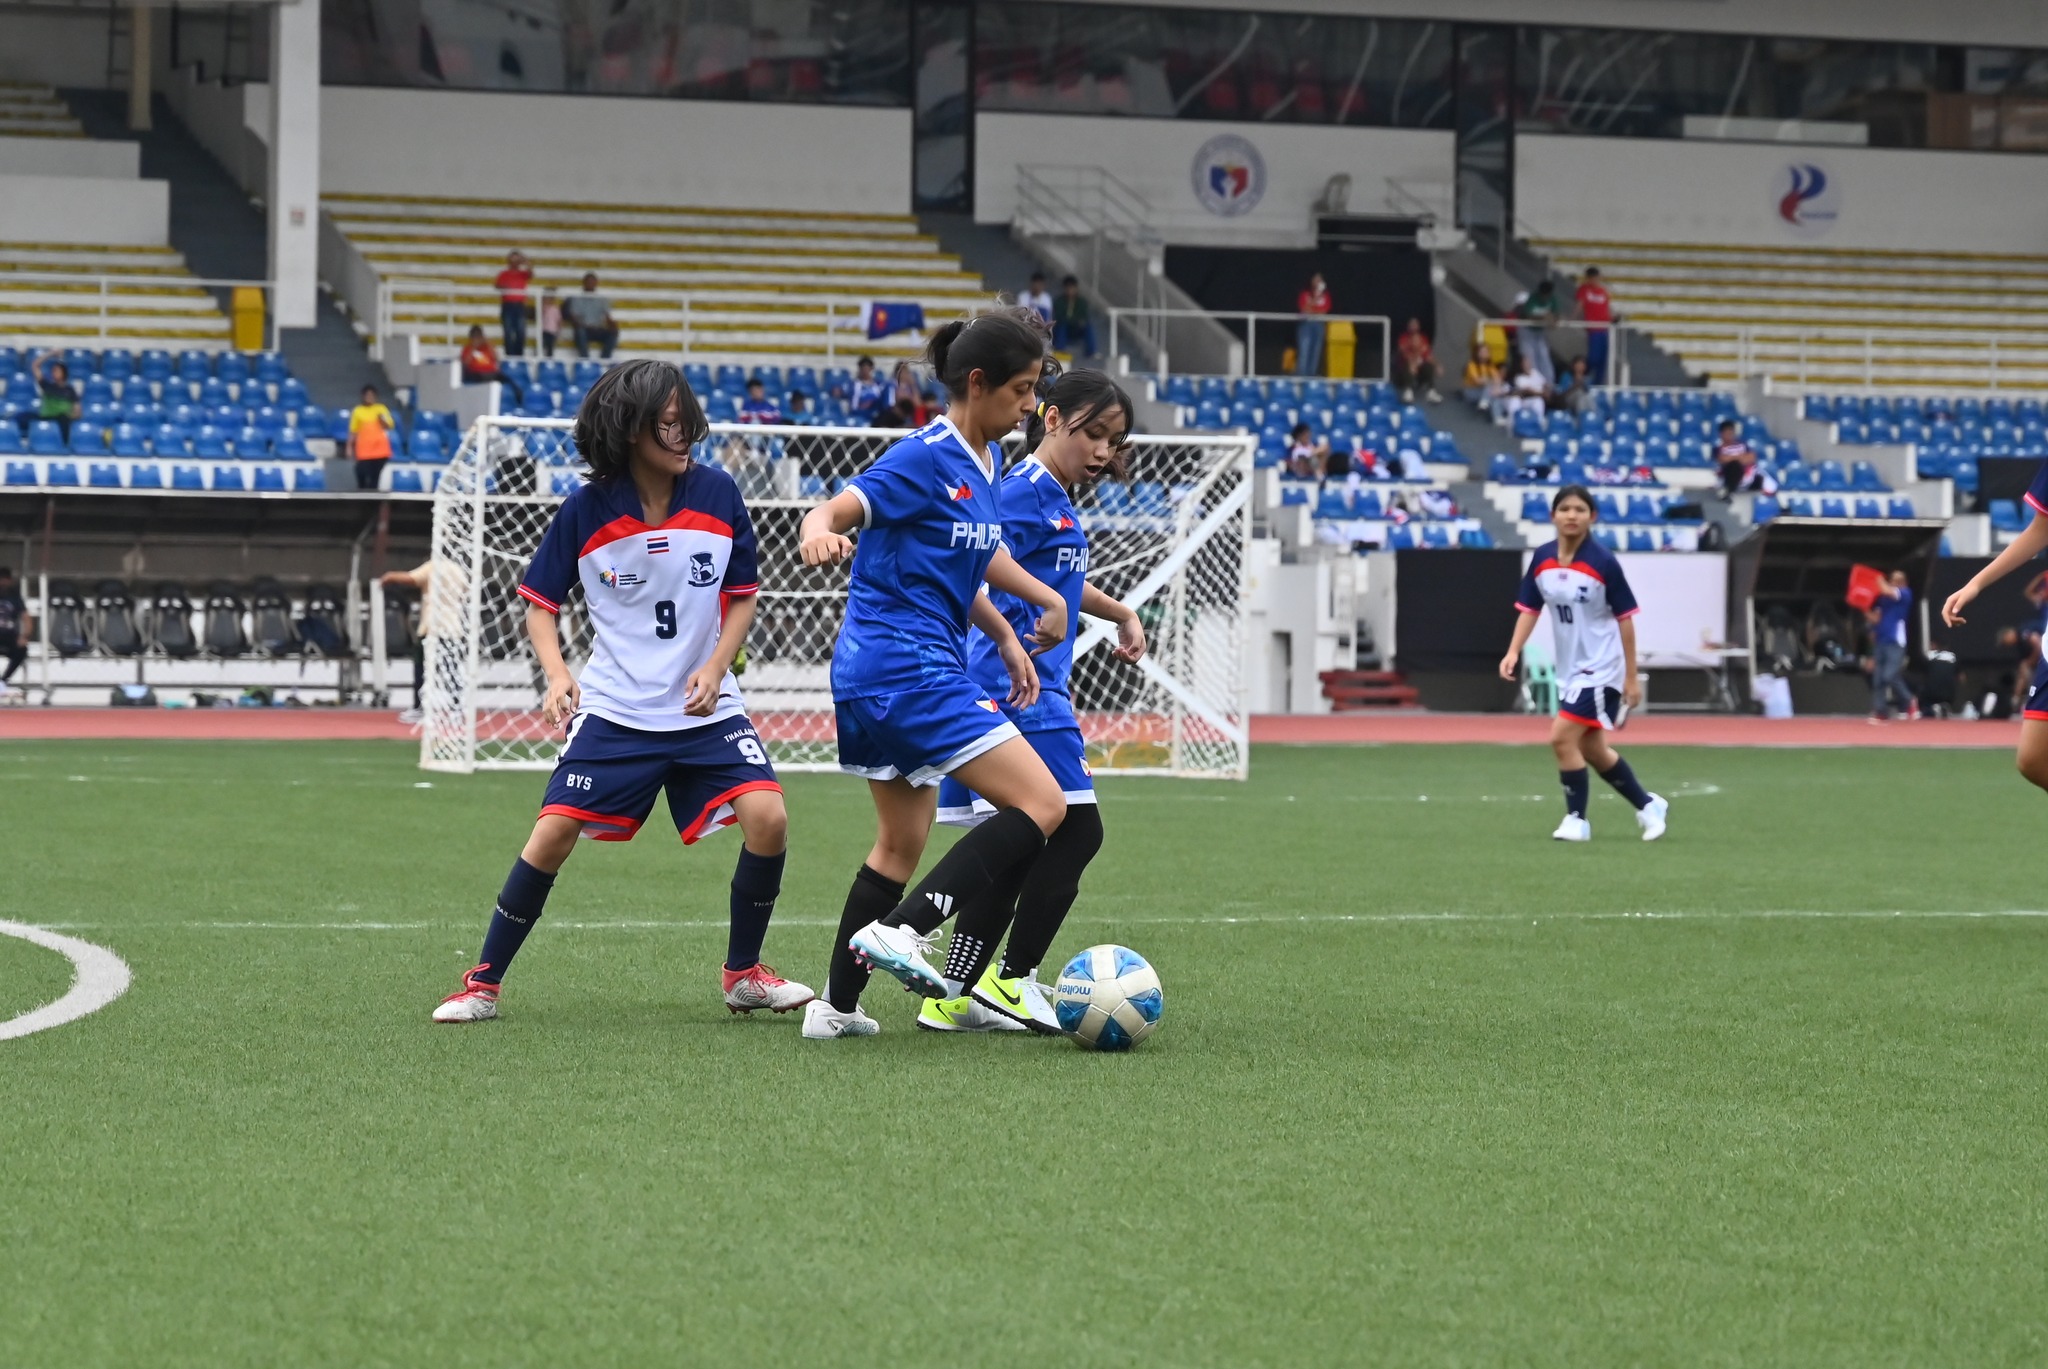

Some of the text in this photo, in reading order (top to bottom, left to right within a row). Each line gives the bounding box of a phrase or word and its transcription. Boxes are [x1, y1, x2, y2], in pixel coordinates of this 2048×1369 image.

[655, 600, 677, 640] 9
[1556, 604, 1573, 624] 10
[737, 737, 767, 765] 9
[566, 773, 593, 791] BYS
[1057, 984, 1091, 996] molten
